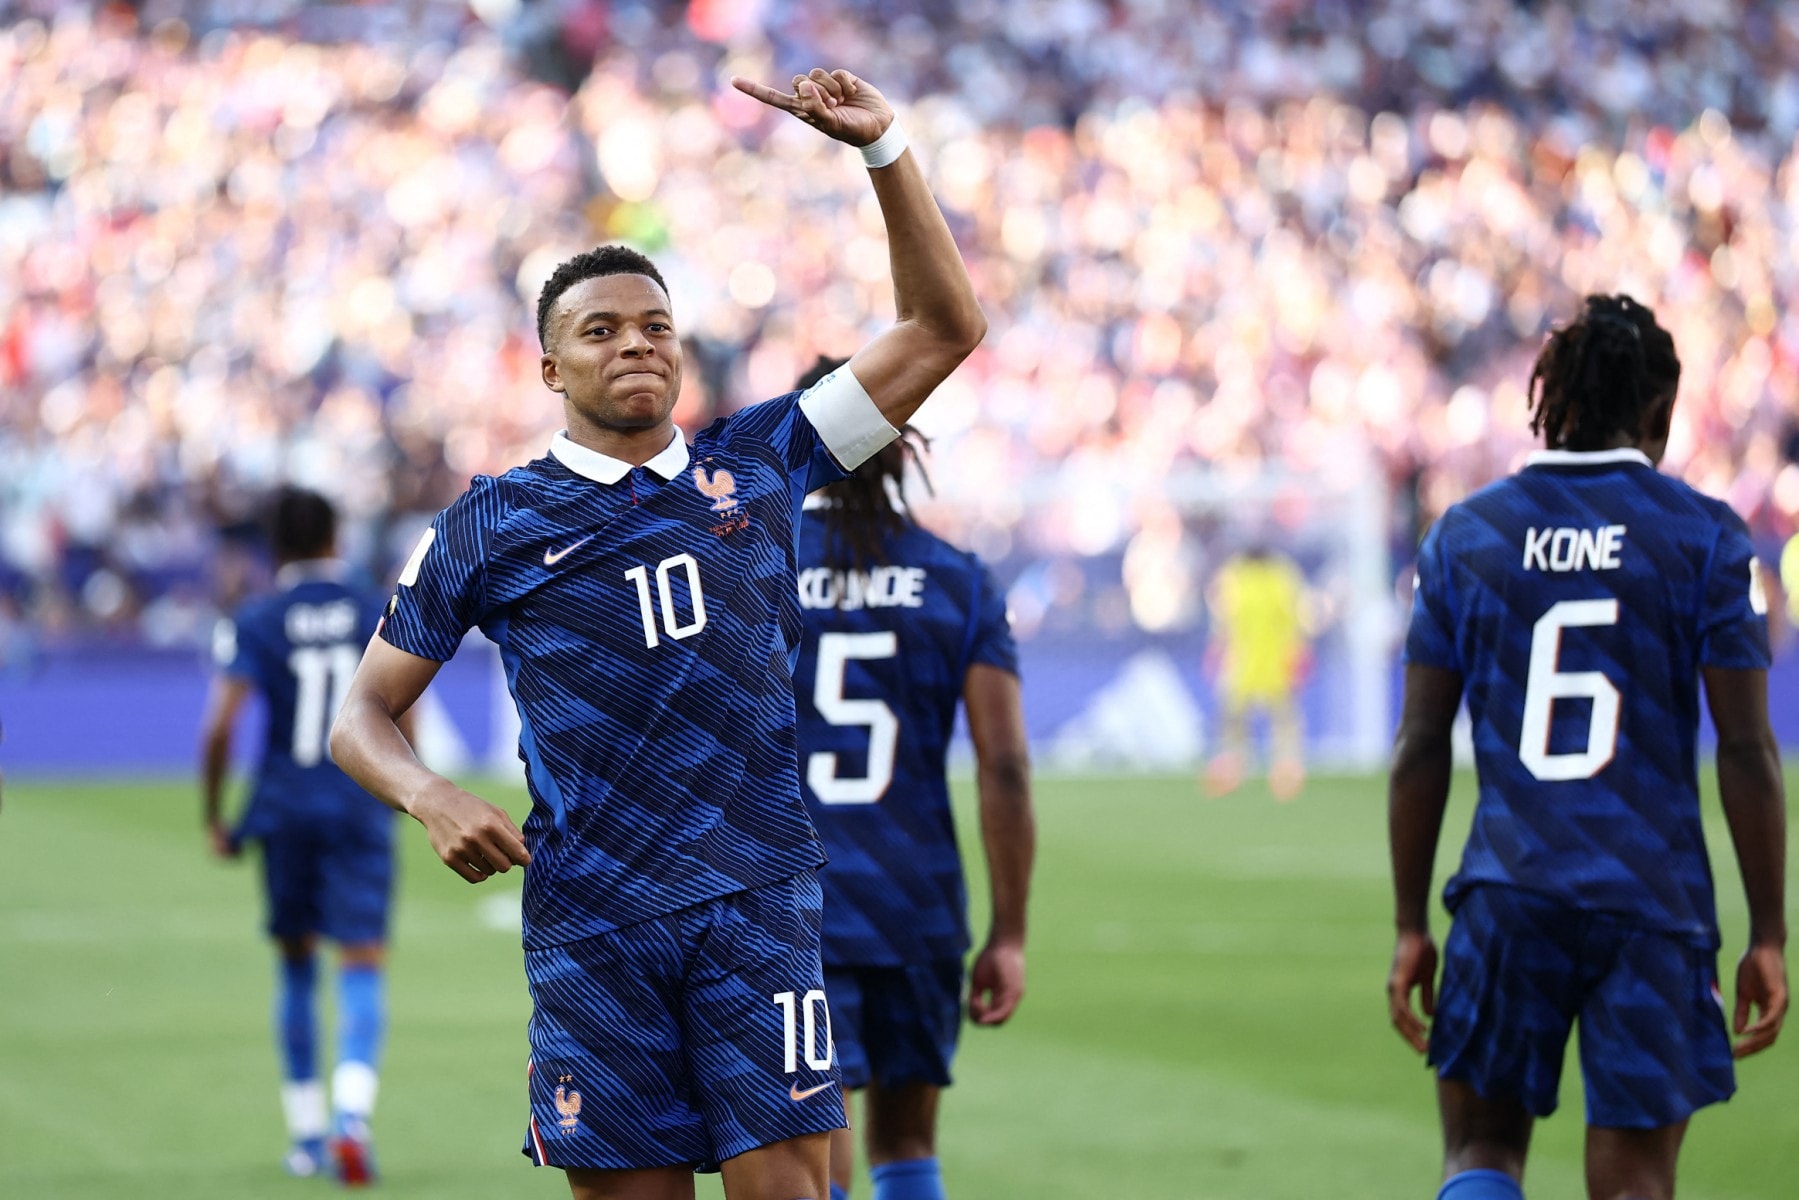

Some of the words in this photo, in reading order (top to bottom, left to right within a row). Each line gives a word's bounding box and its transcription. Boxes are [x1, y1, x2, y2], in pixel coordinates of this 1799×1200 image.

[1523, 525, 1627, 572] KONE
[624, 552, 709, 650] 10
[807, 631, 899, 805] 5
[1519, 598, 1623, 782] 6
[773, 989, 833, 1074] 10
